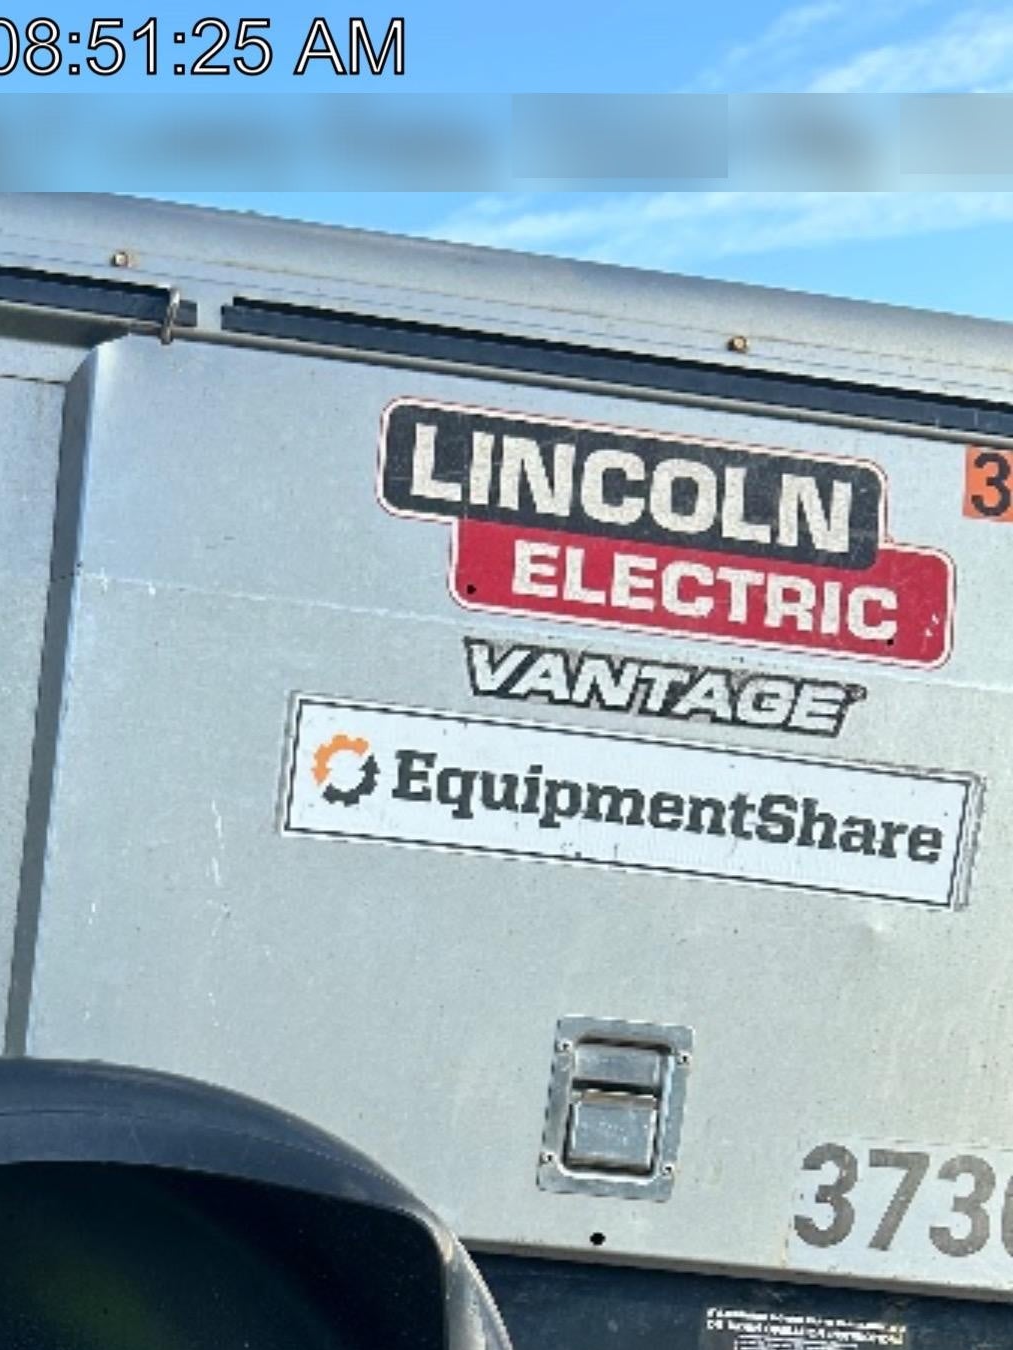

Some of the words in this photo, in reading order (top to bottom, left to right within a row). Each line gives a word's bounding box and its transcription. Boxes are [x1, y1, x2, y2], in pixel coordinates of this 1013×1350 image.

[410, 423, 853, 554] LINCOLN
[511, 538, 899, 641] ELECTRIC
[464, 636, 851, 738] VANTAGE
[391, 748, 944, 864] EquipmentShare
[793, 1142, 1013, 1259] 373
